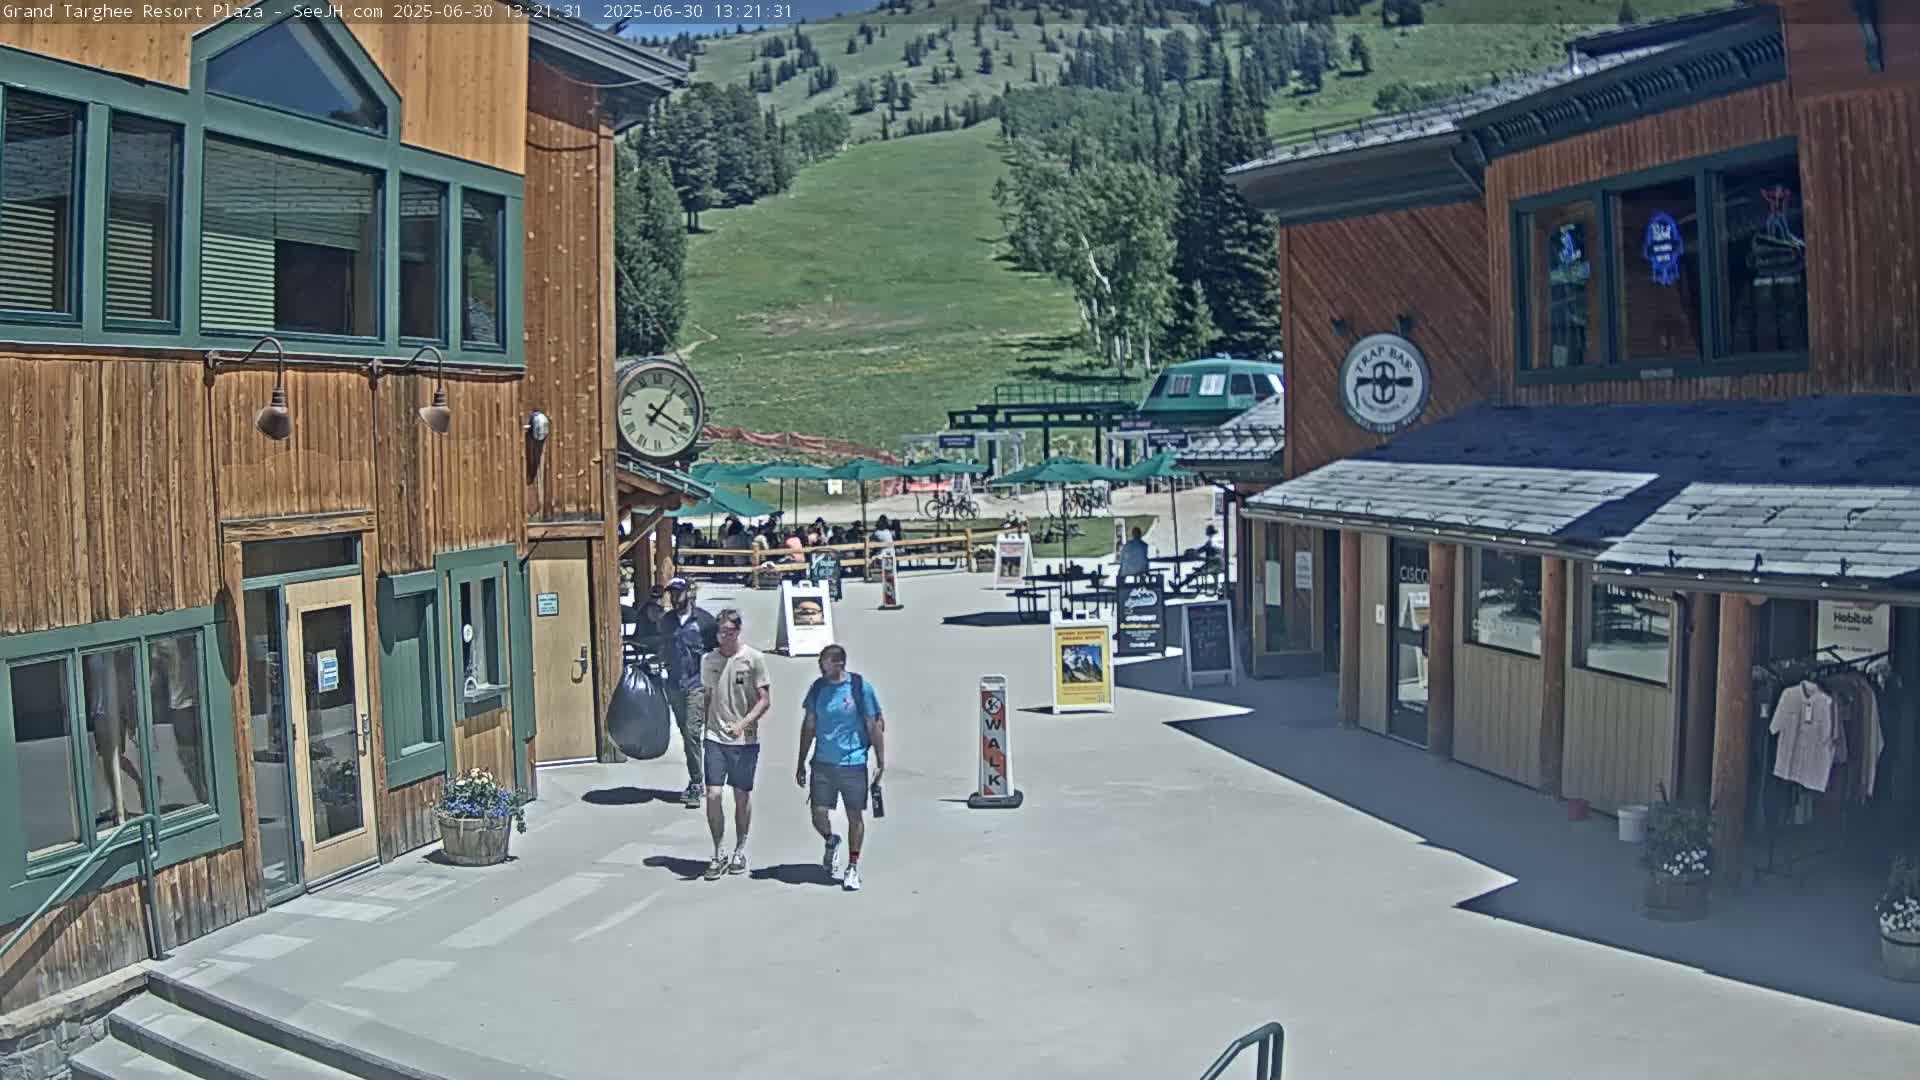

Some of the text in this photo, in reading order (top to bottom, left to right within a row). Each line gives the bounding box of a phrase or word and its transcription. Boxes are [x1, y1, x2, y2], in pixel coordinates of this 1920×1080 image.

[1355, 346, 1413, 374] TRAP BAR
[1833, 611, 1873, 625] Habitat
[984, 719, 1002, 786] WALK
